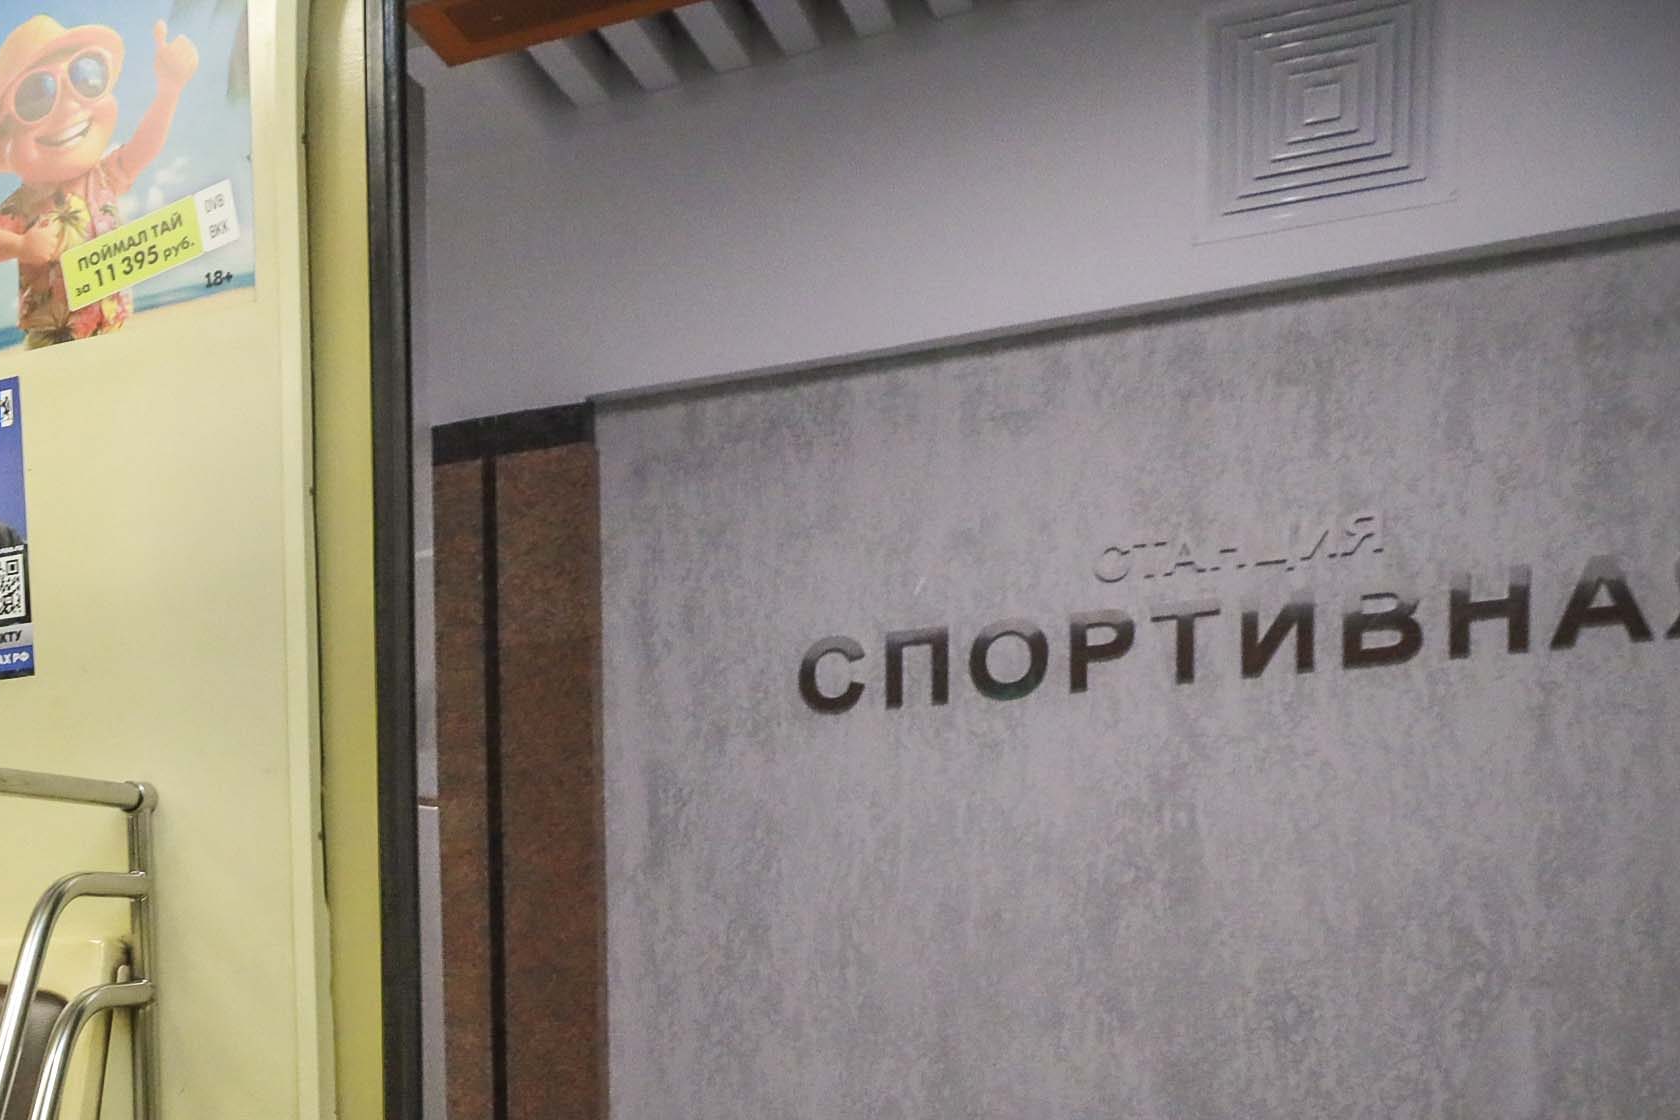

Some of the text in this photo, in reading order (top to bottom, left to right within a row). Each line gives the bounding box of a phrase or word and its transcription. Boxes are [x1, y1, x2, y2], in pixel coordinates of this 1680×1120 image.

[75, 284, 91, 296] за
[163, 235, 195, 262] руб.
[78, 211, 183, 271] ПОЙМАЛ ТАЙ
[205, 270, 233, 289] 18+
[1094, 514, 1384, 584] СТАНЦИЯ
[13, 651, 30, 665] РФ
[797, 552, 1680, 717] СПОРТИВНА
